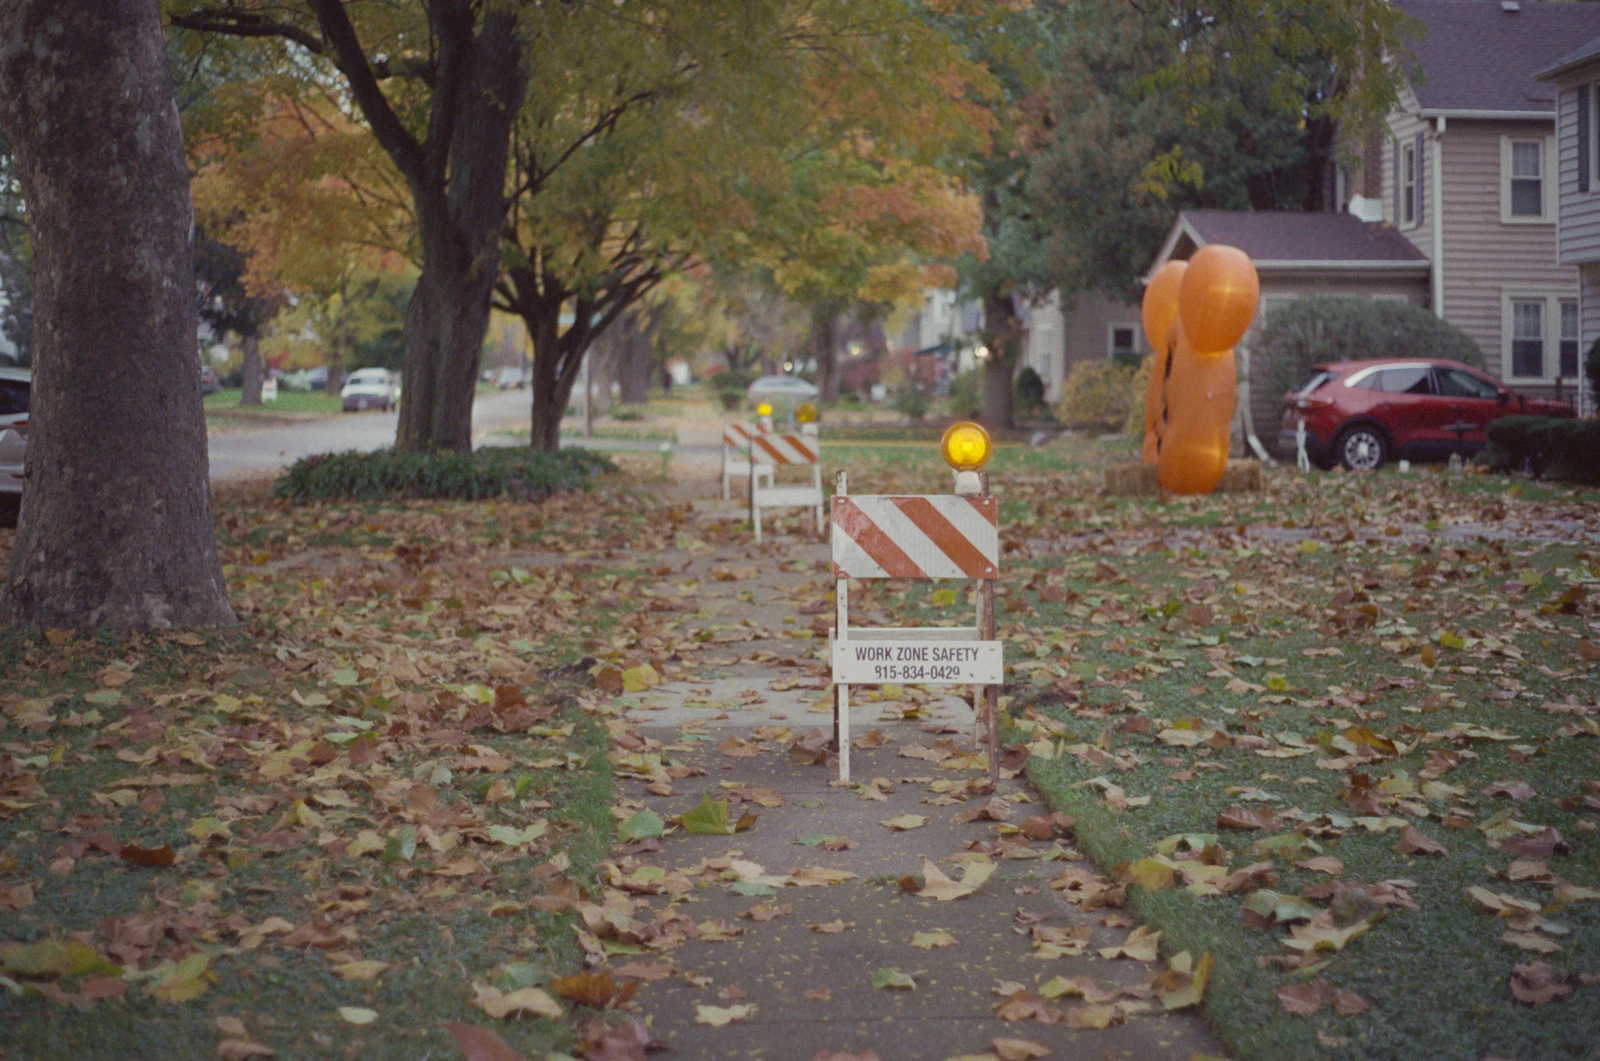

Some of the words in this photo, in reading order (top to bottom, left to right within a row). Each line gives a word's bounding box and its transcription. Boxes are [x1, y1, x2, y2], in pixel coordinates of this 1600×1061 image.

[855, 647, 893, 661] WORK
[896, 647, 929, 661] ZONE
[932, 647, 979, 661] SAFETY
